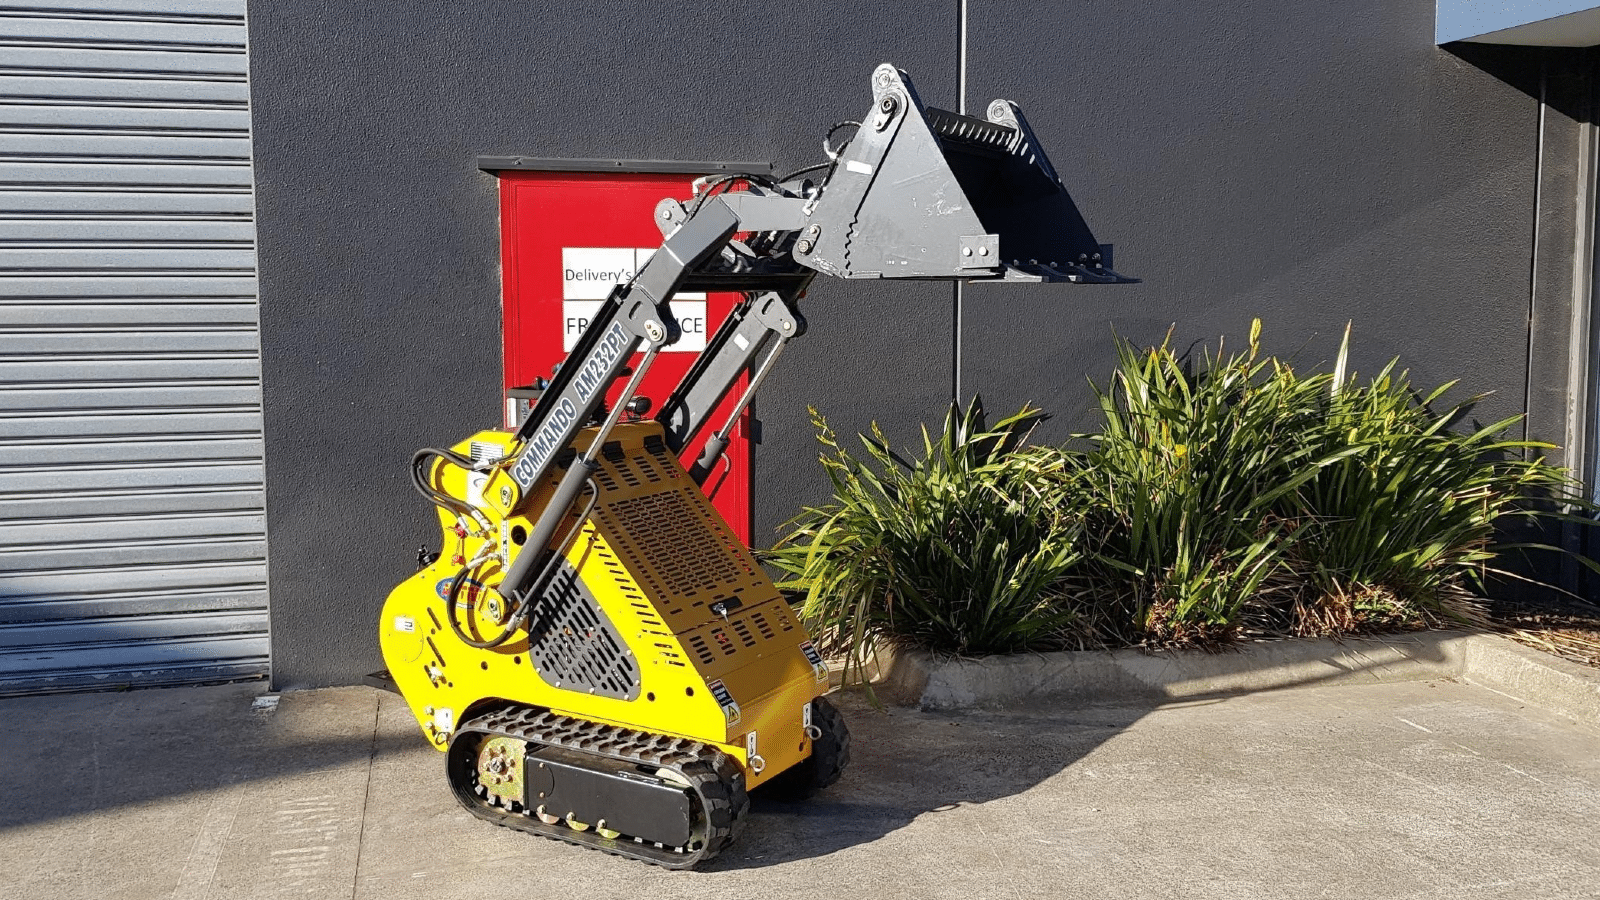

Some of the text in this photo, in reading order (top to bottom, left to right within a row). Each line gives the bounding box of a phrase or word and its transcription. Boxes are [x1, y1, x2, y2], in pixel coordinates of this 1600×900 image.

[565, 268, 632, 283] Delivery's
[514, 321, 628, 487] COMMANDO AM232PT
